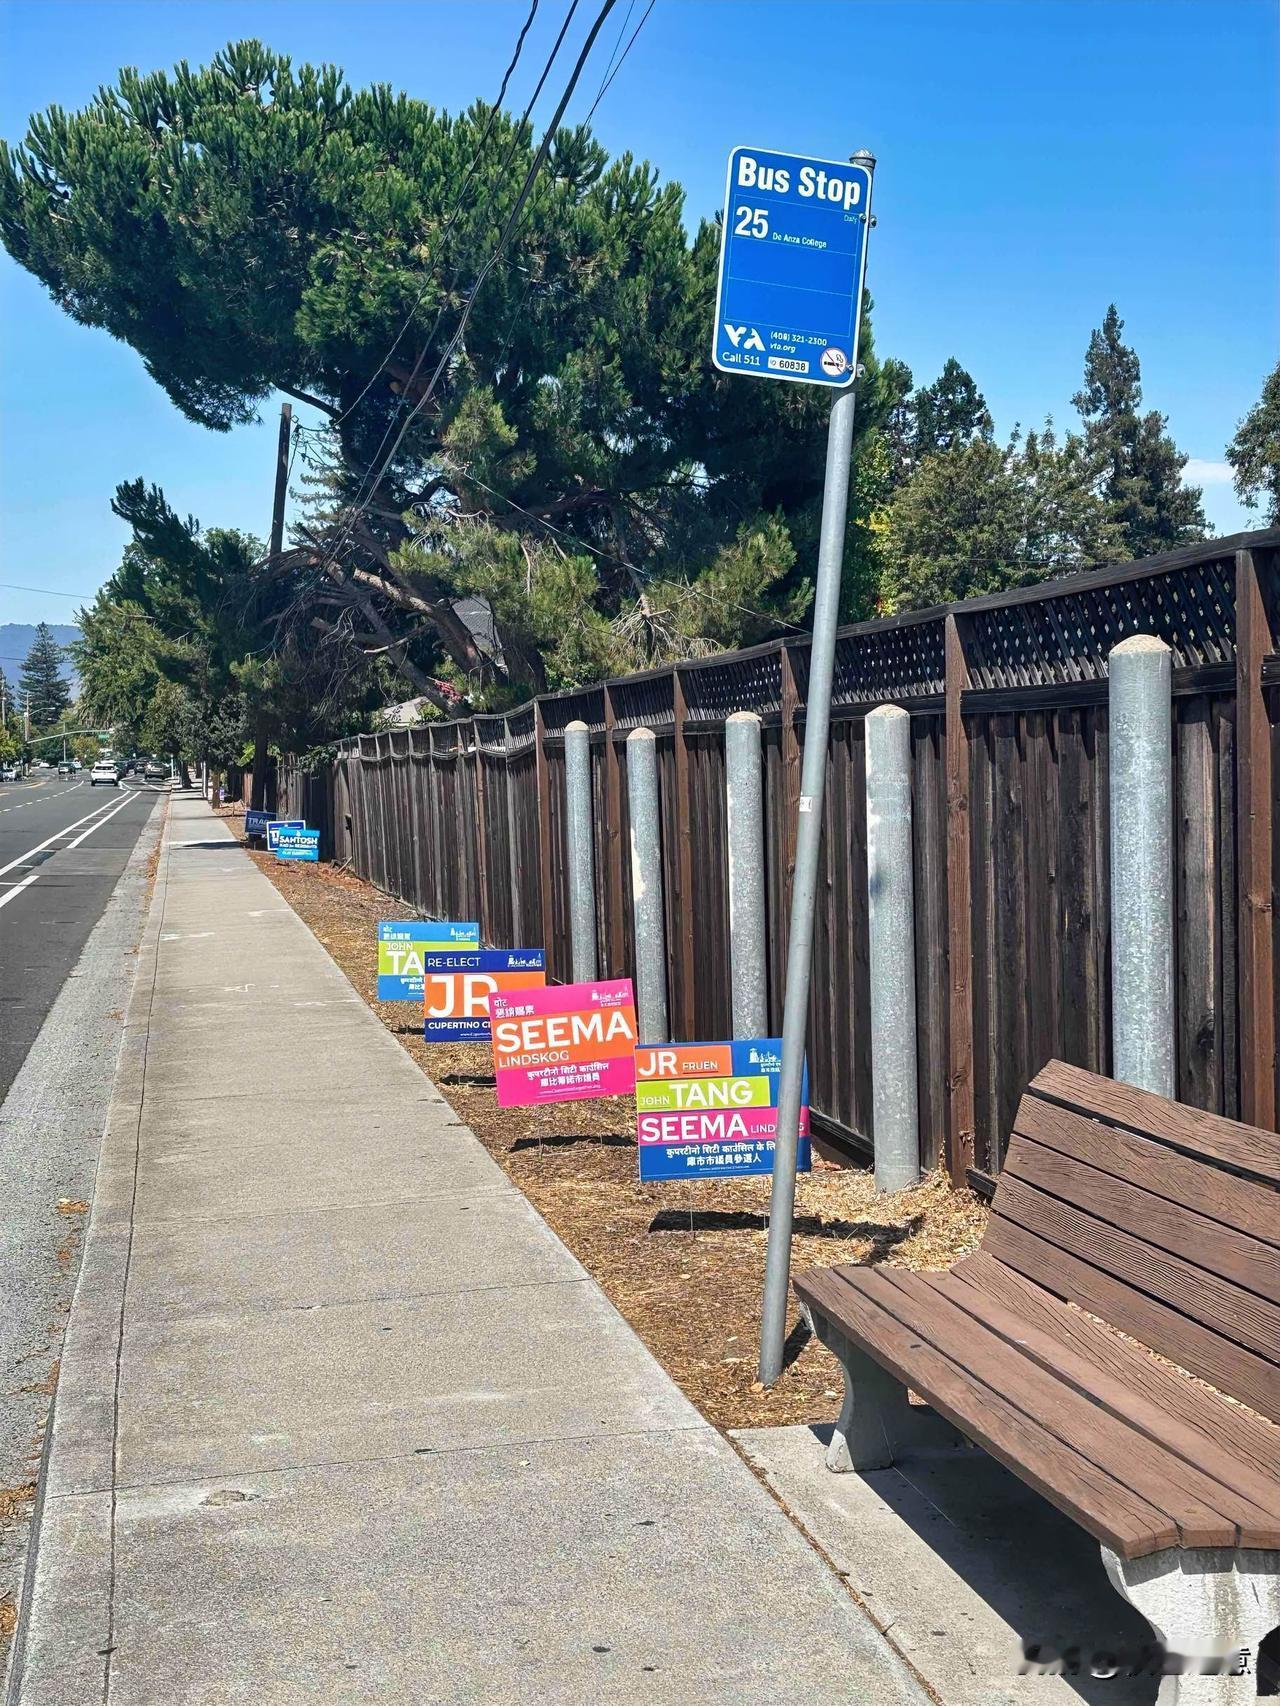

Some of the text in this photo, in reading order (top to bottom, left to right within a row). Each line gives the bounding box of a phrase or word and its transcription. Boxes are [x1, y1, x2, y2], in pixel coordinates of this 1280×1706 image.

[738, 156, 861, 210] Bus Stop
[734, 206, 827, 248] 25 De Anza College
[770, 331, 827, 346] (408) 321-2300
[770, 343, 796, 354] vta.org
[722, 352, 760, 365] Call 511
[779, 360, 806, 371] 60838
[279, 836, 318, 844] SANTOSH
[387, 942, 413, 950] JOHN
[386, 950, 424, 975] TA
[428, 957, 481, 967] RE-ELECT
[428, 974, 498, 1018] JR
[428, 1021, 480, 1030] CUPERTINO
[496, 1011, 633, 1053] SEEMA
[499, 1050, 569, 1068] LINDSKOG
[638, 1051, 718, 1076] JR FRUEN
[640, 1080, 753, 1108] JOHN TANG
[641, 1113, 749, 1142] SEEMA
